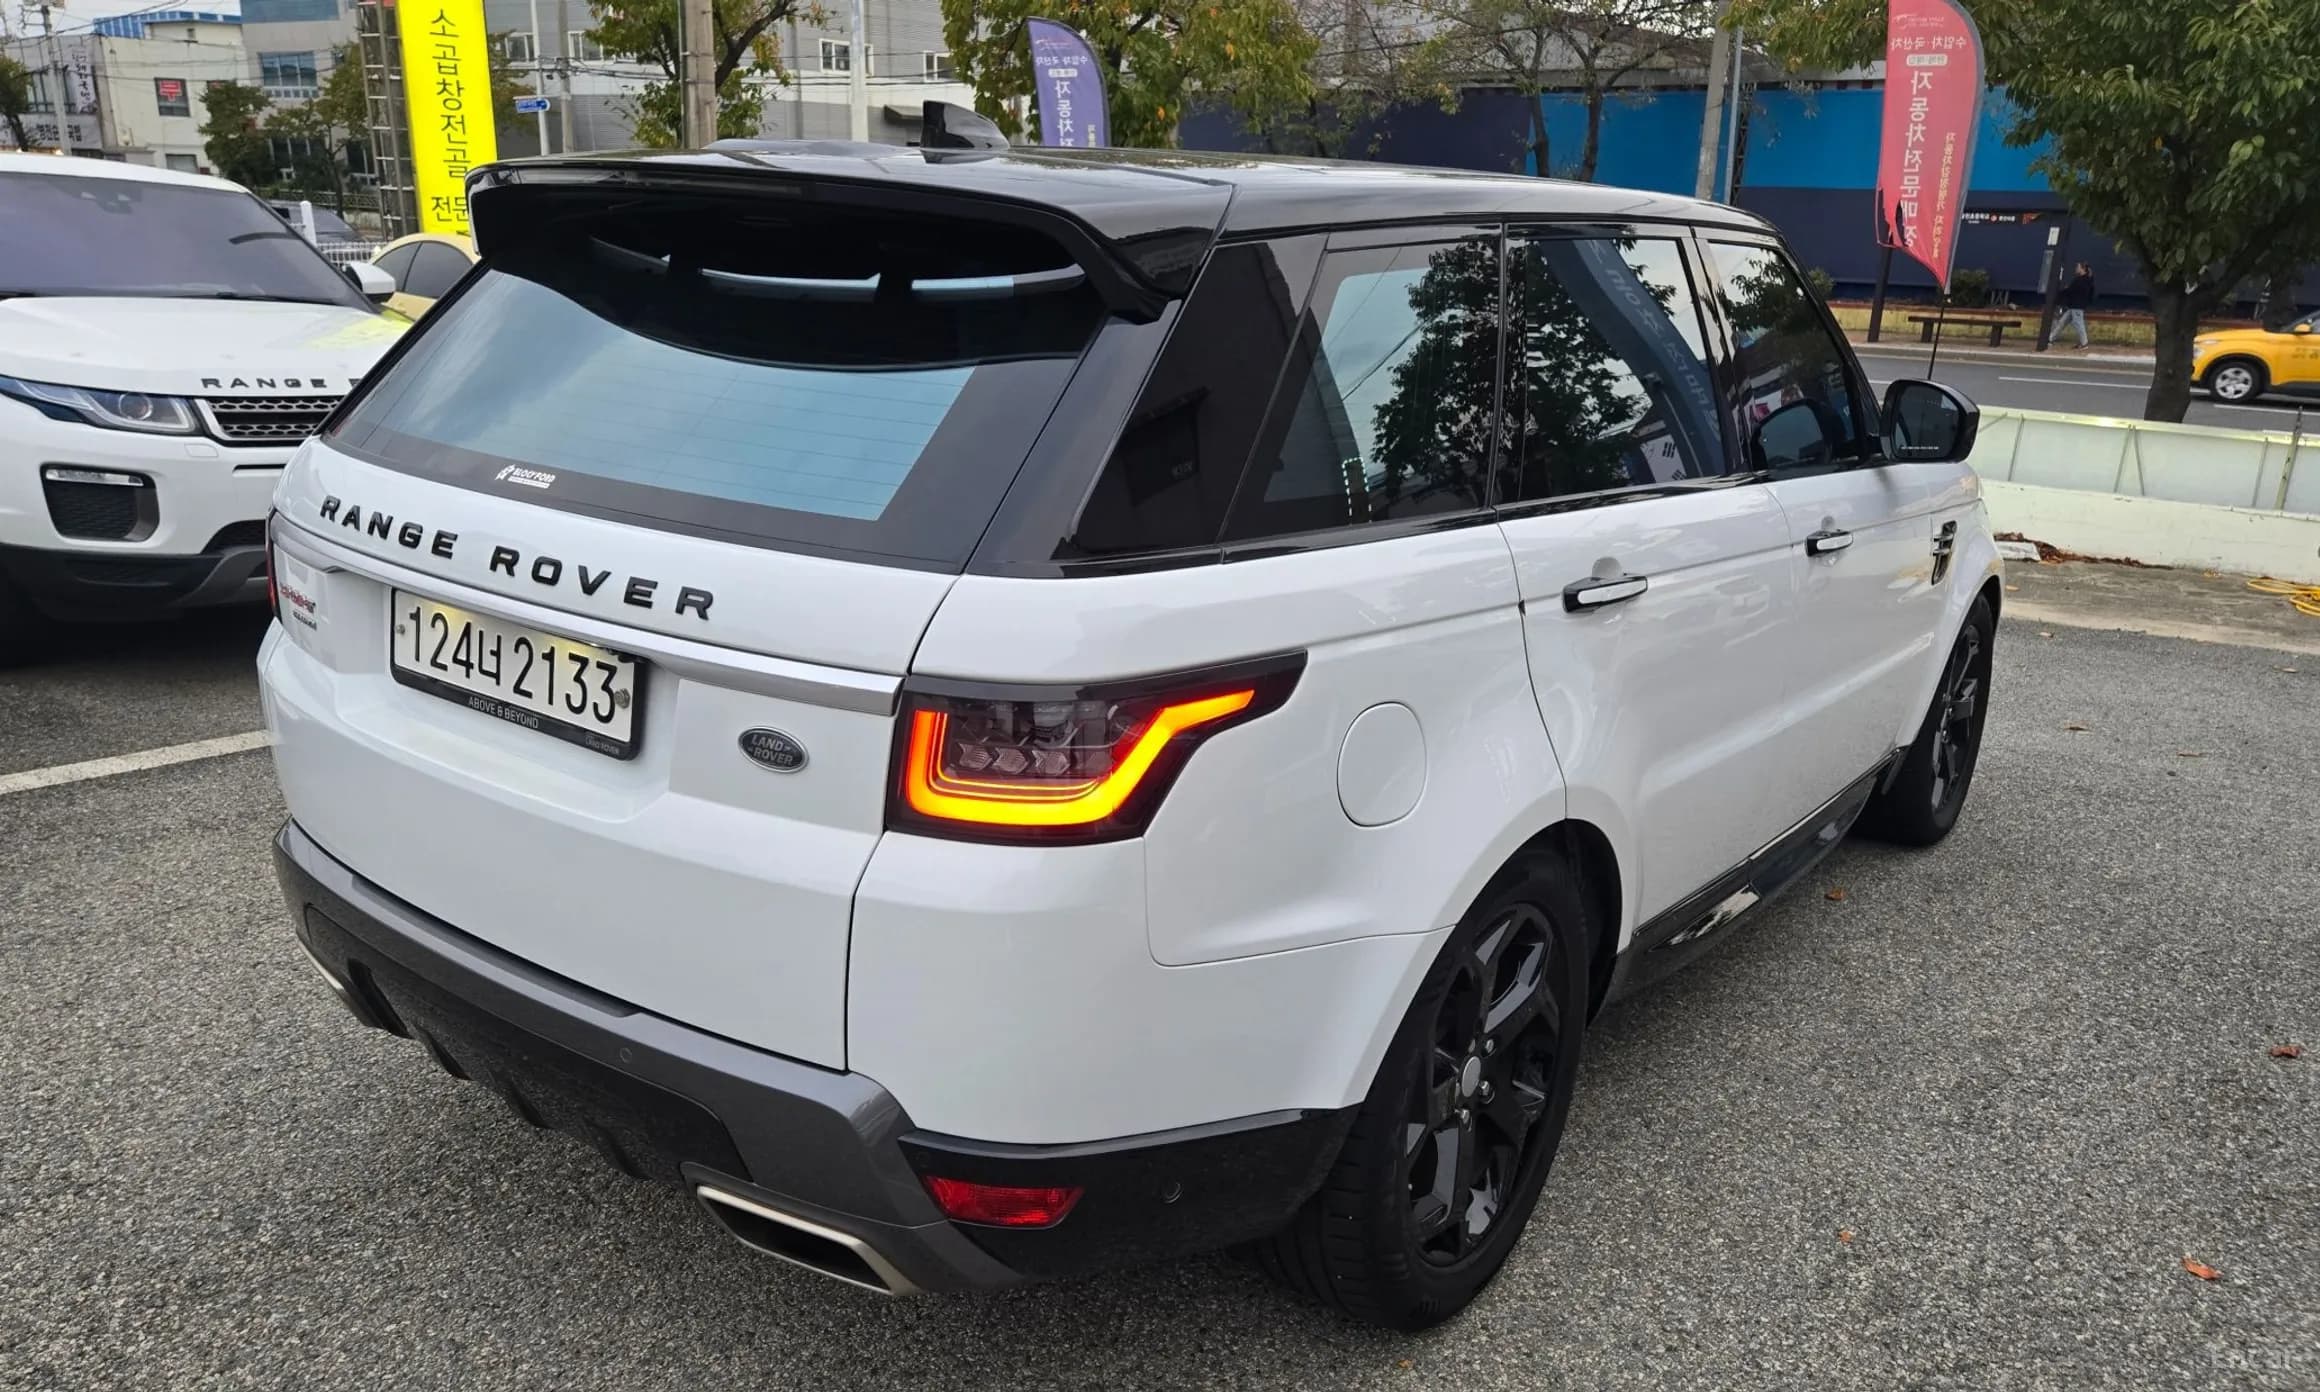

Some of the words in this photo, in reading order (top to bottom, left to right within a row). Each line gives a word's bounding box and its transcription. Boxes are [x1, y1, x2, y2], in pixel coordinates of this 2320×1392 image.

[429, 8, 472, 179] 소곱창전골
[200, 378, 328, 389] RANGE
[320, 495, 458, 559] RANGE
[489, 545, 714, 620] ROVER
[409, 606, 501, 686] 124너
[513, 636, 618, 724] 2133
[468, 697, 495, 714] ABOVE
[504, 707, 539, 729] BEYOND
[751, 734, 784, 752] LAND
[753, 747, 793, 766] ROVER
